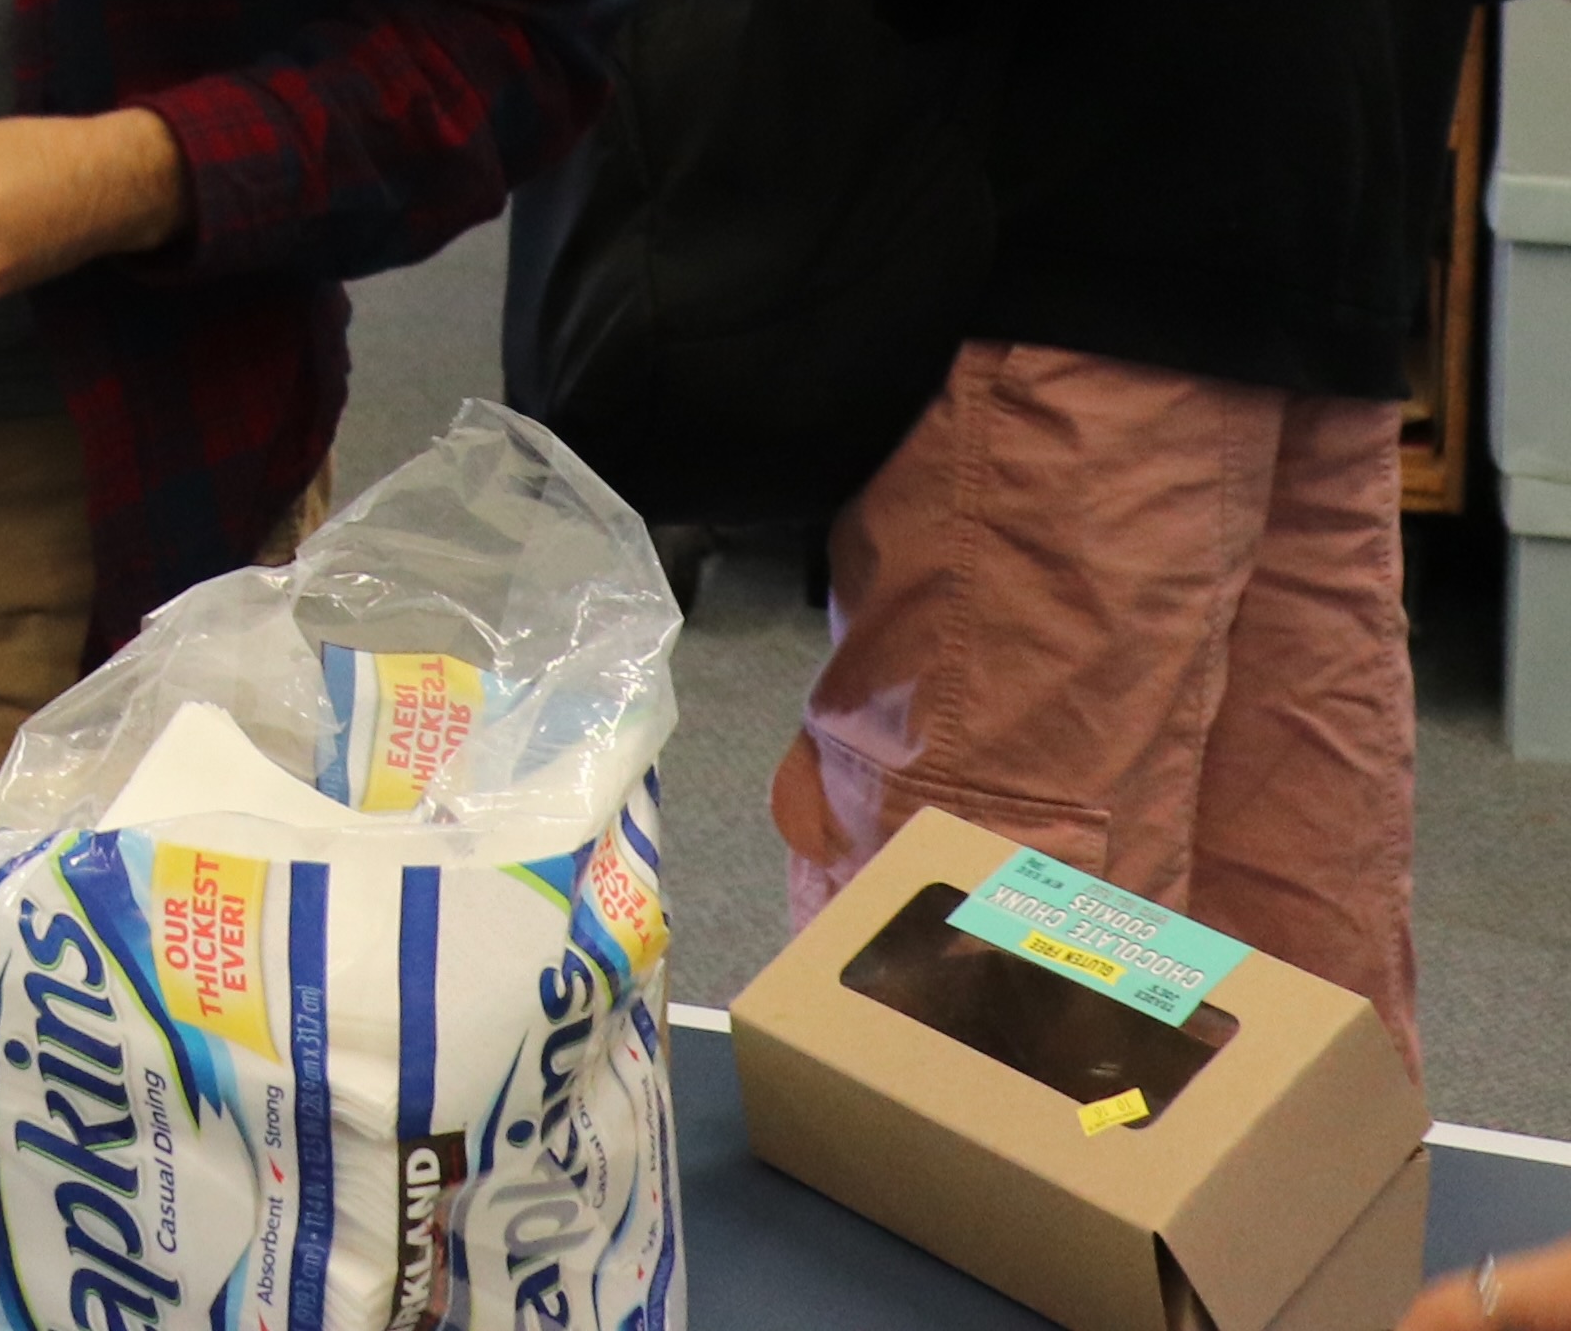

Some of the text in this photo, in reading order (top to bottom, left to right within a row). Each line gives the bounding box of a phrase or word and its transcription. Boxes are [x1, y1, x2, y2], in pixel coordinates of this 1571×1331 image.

[164, 899, 191, 971] OUR
[193, 853, 225, 1017] THICKEST
[220, 895, 248, 993] EVER!
[986, 885, 1205, 990] CHOCOLATE CHUNK
[1029, 937, 1114, 978] GLUTEN FREE
[1067, 893, 1157, 941] COOKIES
[5, 892, 181, 1331] apkins
[141, 1068, 179, 1254] Casual Dining
[491, 947, 595, 1331] apkins
[256, 1084, 284, 1306] Absorbent Strong
[388, 1148, 441, 1331] IRKLAND
